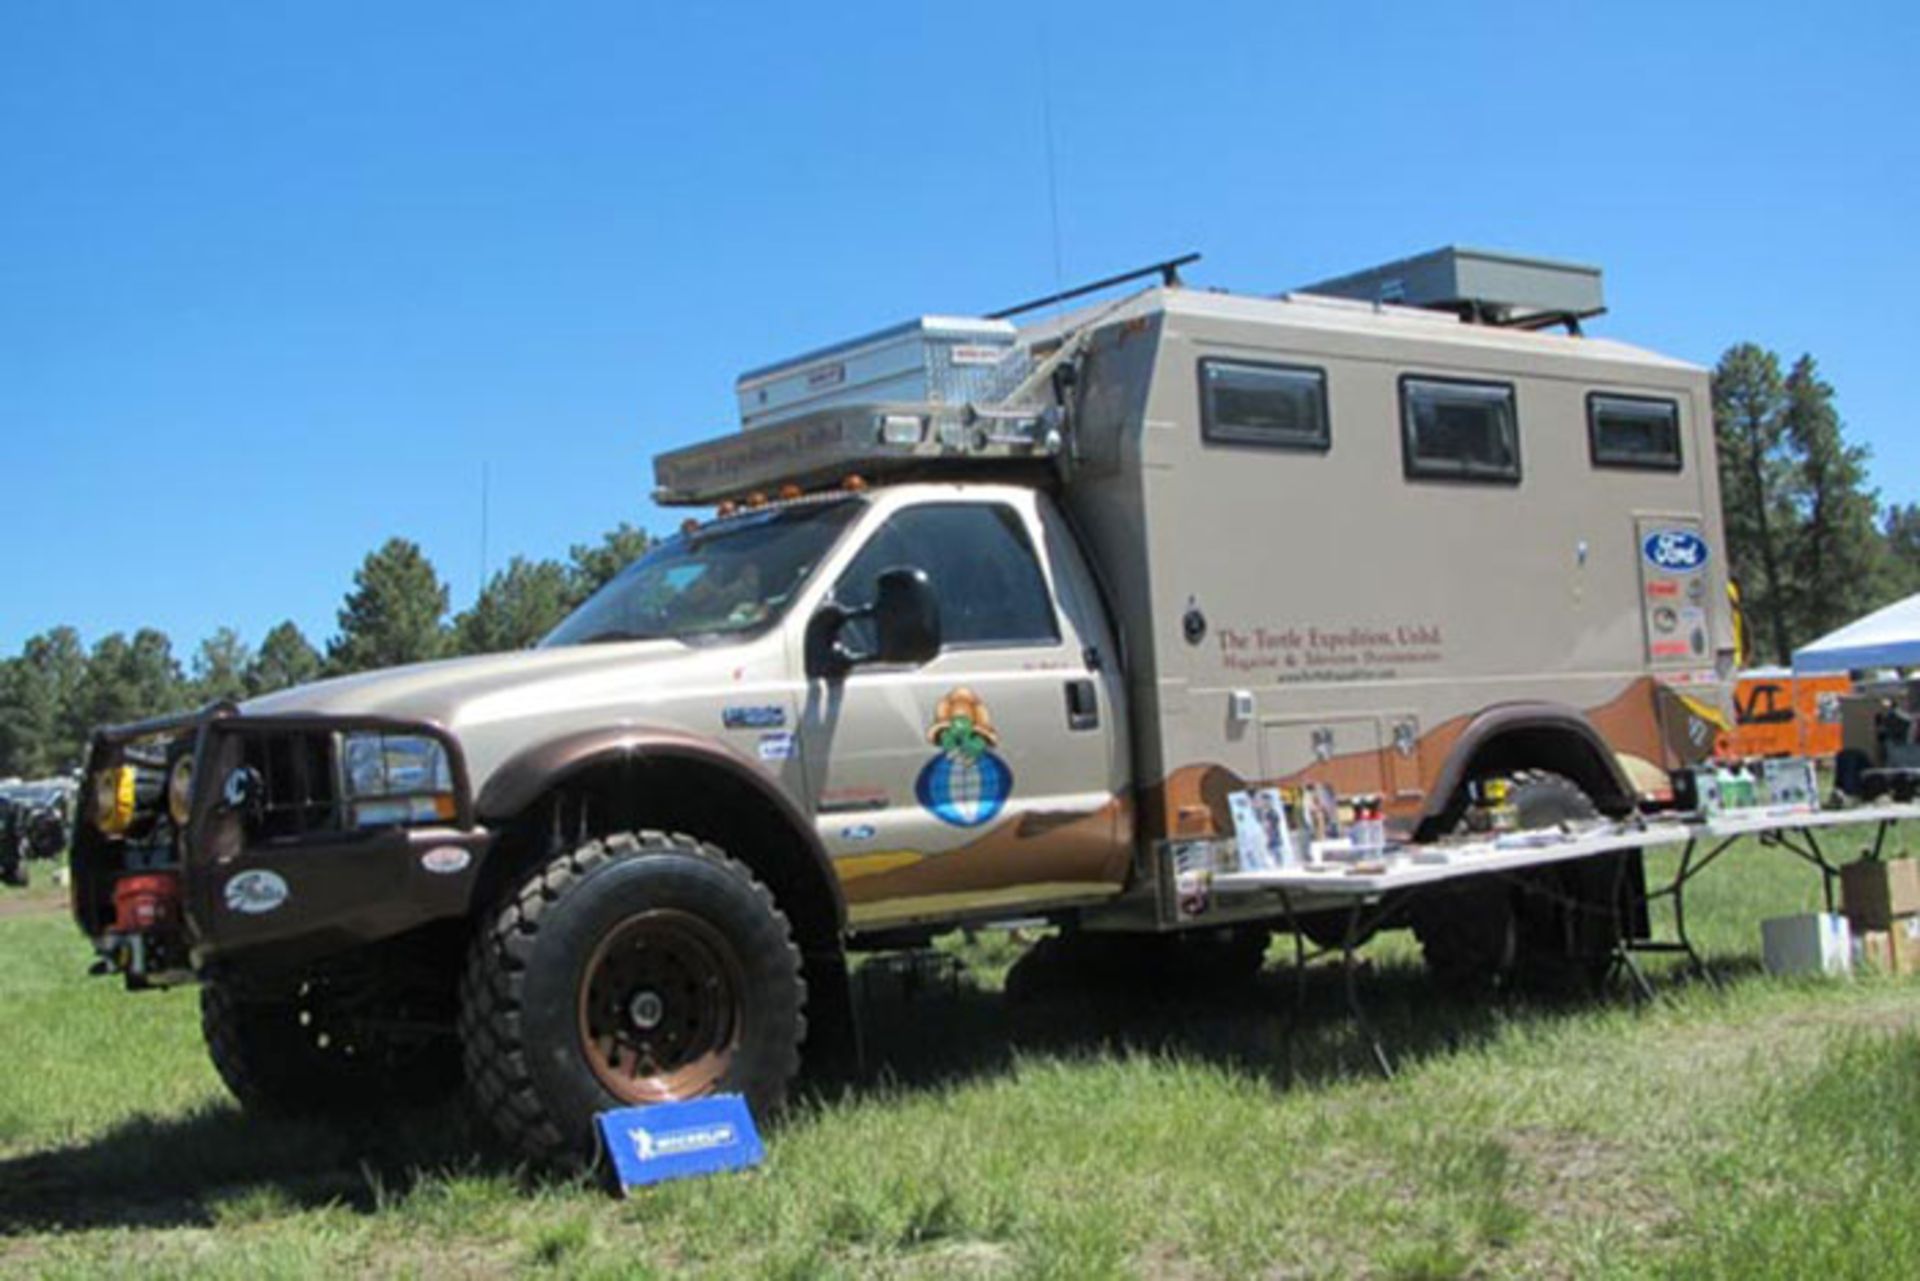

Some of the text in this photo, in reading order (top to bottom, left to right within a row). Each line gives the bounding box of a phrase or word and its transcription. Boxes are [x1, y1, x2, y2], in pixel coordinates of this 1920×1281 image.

[1652, 532, 1699, 564] Ford
[1217, 628, 1249, 652] The
[1254, 627, 1301, 651] Turtle
